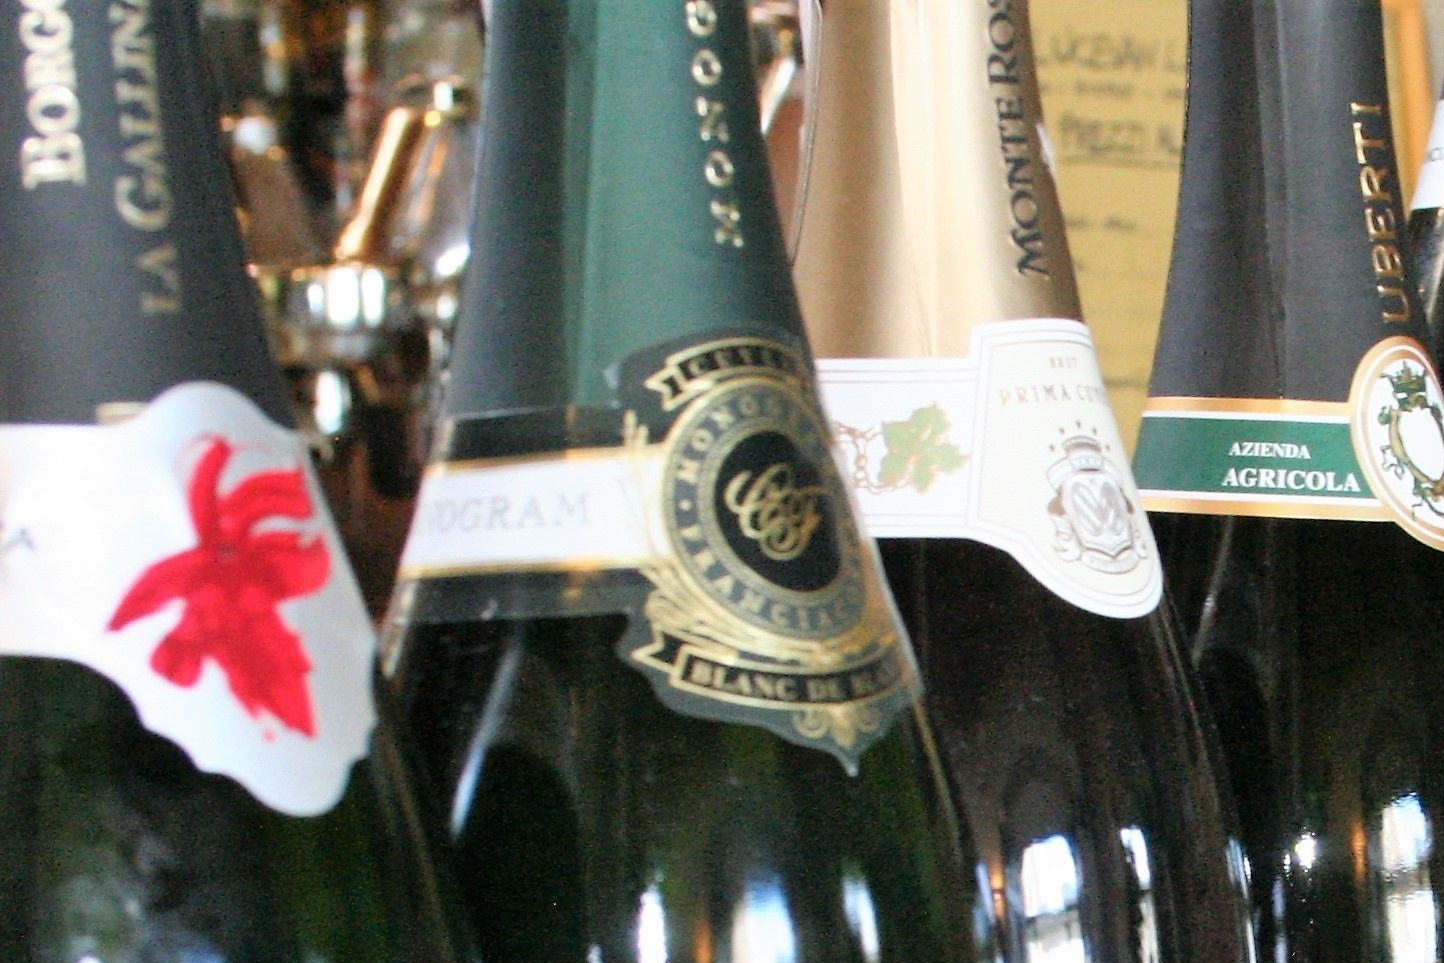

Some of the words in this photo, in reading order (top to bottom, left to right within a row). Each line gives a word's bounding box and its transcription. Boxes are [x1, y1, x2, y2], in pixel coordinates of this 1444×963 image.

[19, 0, 86, 190] BORG
[108, 0, 173, 231] GALLIN
[995, 96, 1052, 280] MONTE
[1350, 100, 1410, 324] UBERTI
[1222, 466, 1361, 492] AGRICOLA
[1228, 441, 1311, 460] AZIENDA
